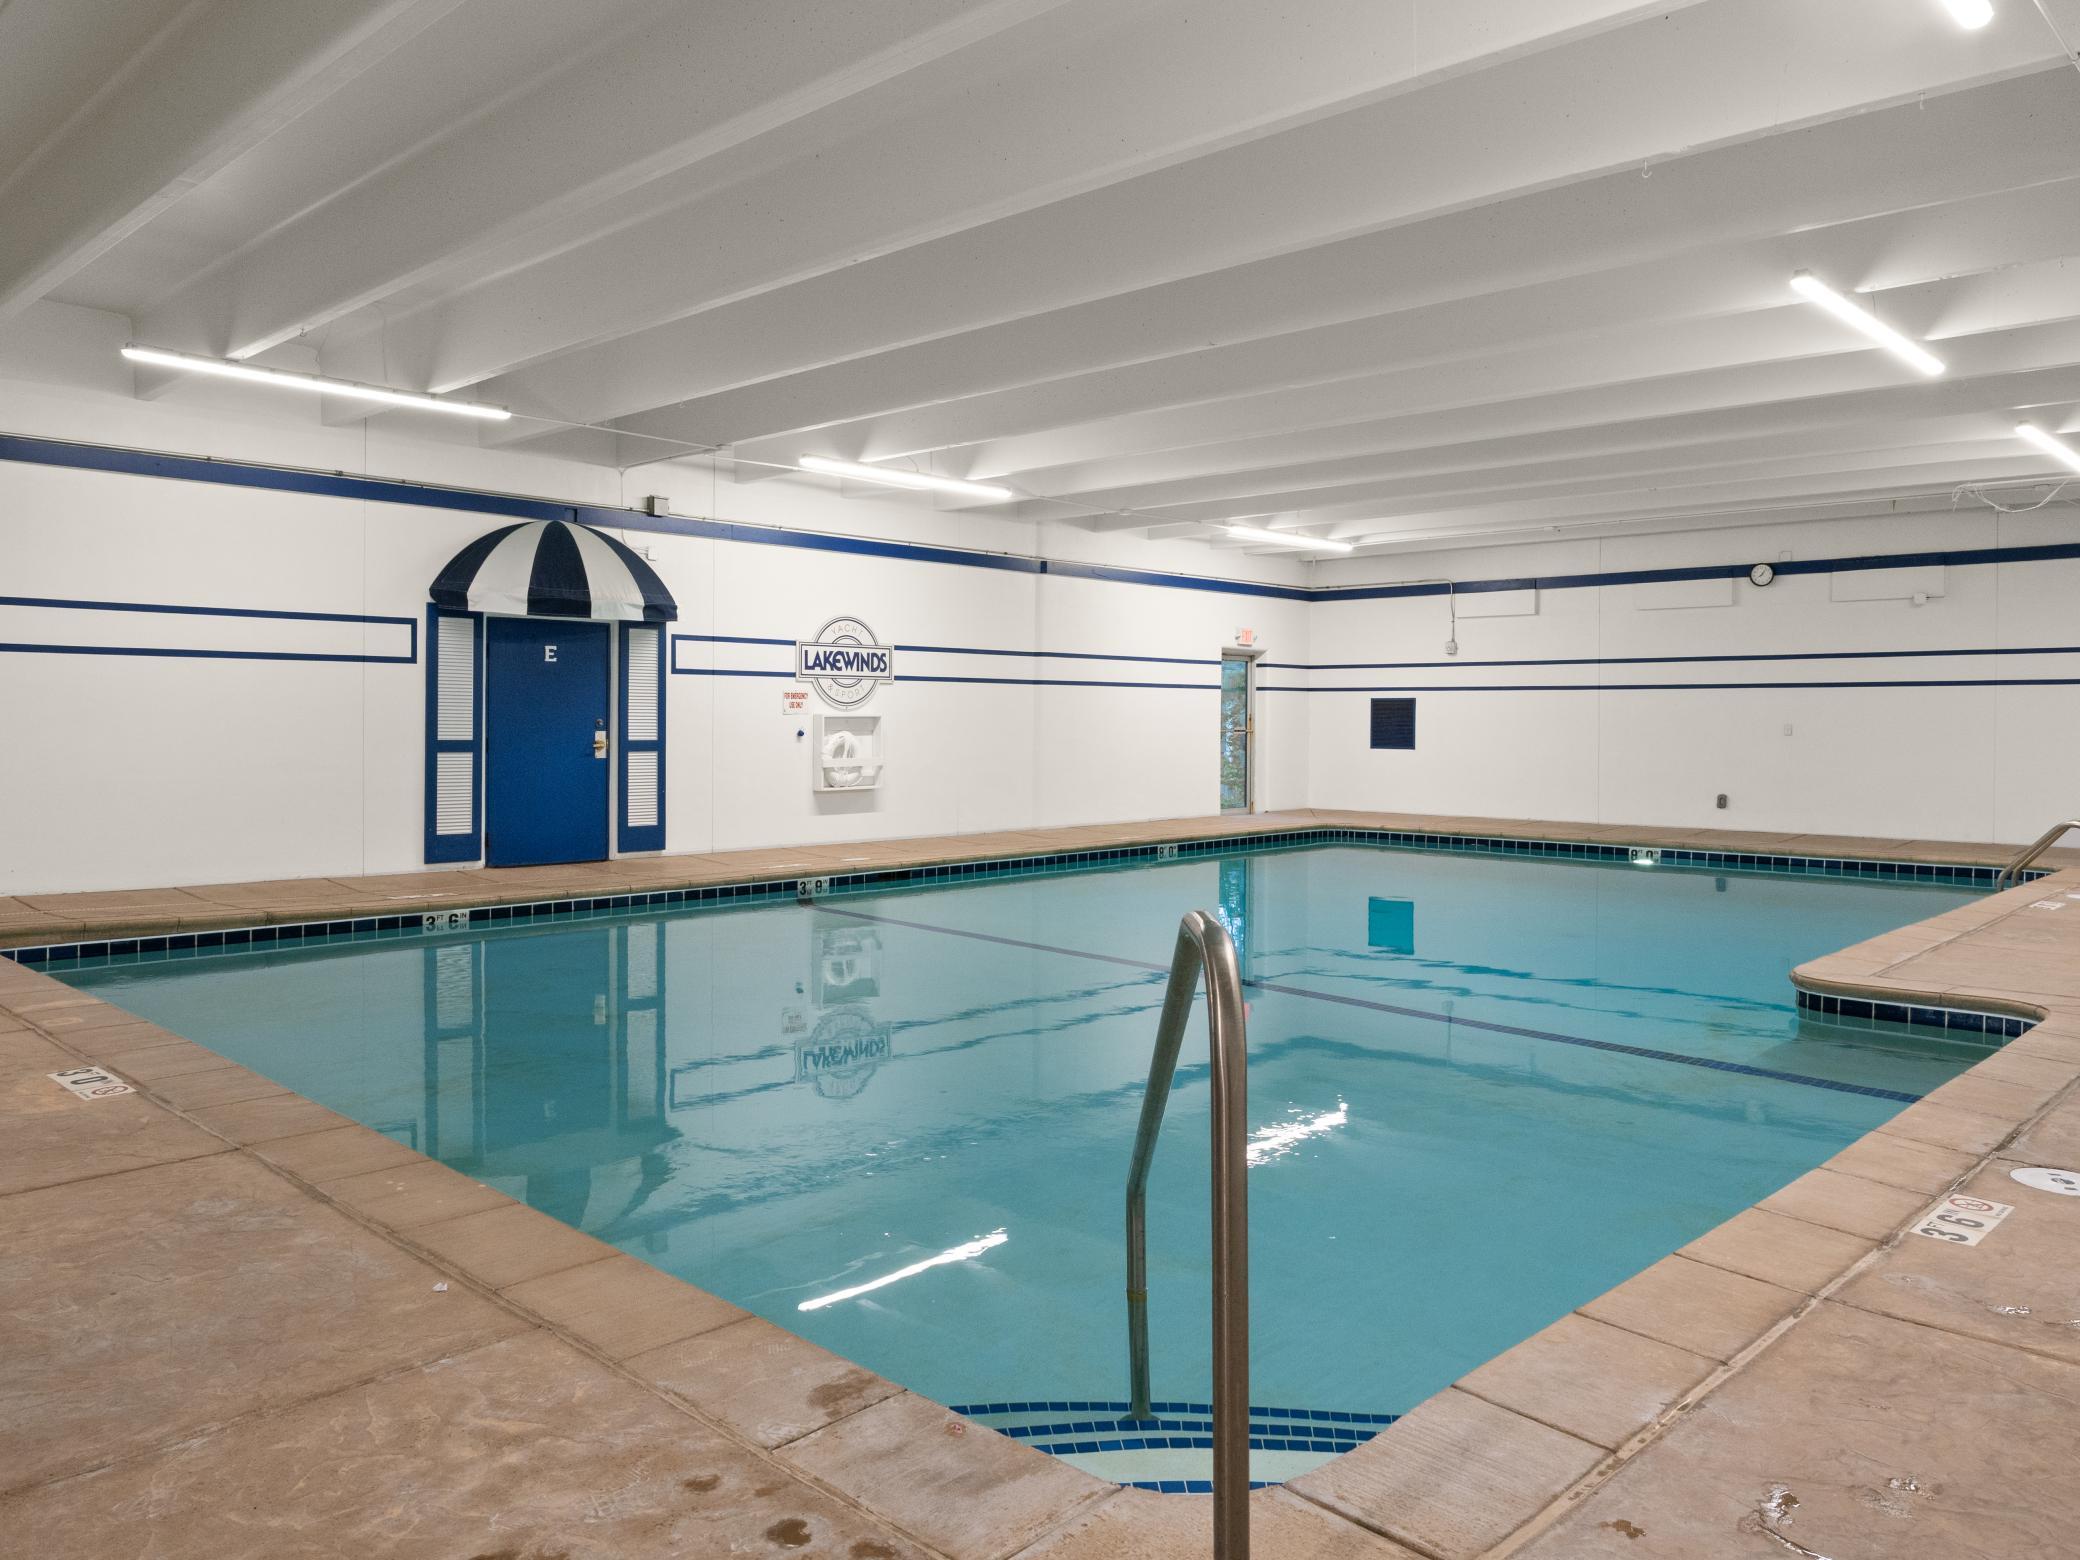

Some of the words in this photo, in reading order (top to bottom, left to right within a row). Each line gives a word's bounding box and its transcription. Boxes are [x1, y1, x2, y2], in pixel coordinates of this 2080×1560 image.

[831, 624, 864, 637] YACHT
[544, 645, 557, 661] E
[804, 650, 887, 672] LAKEWINDS
[800, 881, 806, 895] 3
[1937, 1214, 1984, 1228] 6
[1921, 1227, 1968, 1242] 3
